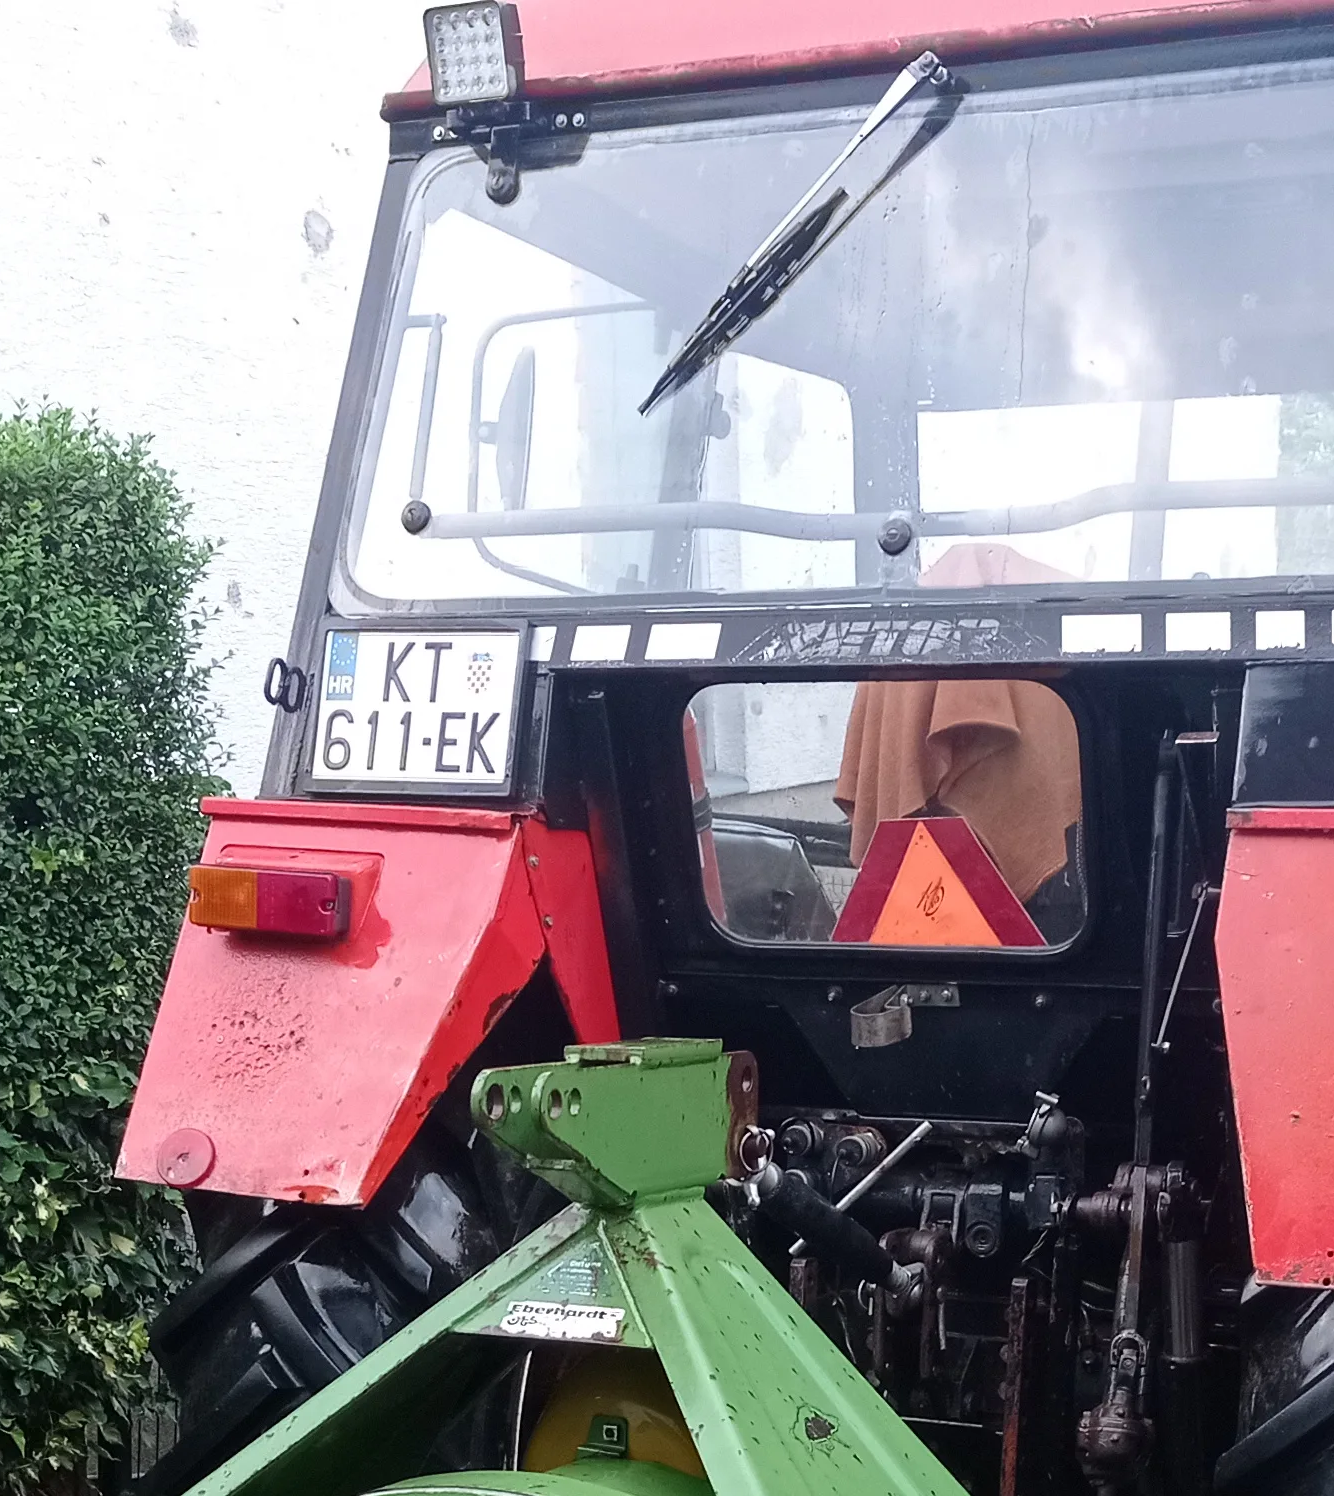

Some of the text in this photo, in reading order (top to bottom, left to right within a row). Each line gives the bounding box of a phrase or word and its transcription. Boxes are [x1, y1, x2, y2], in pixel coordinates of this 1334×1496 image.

[383, 641, 453, 703] KT
[328, 675, 355, 695] HR
[512, 1304, 608, 1320] Eberhardt
